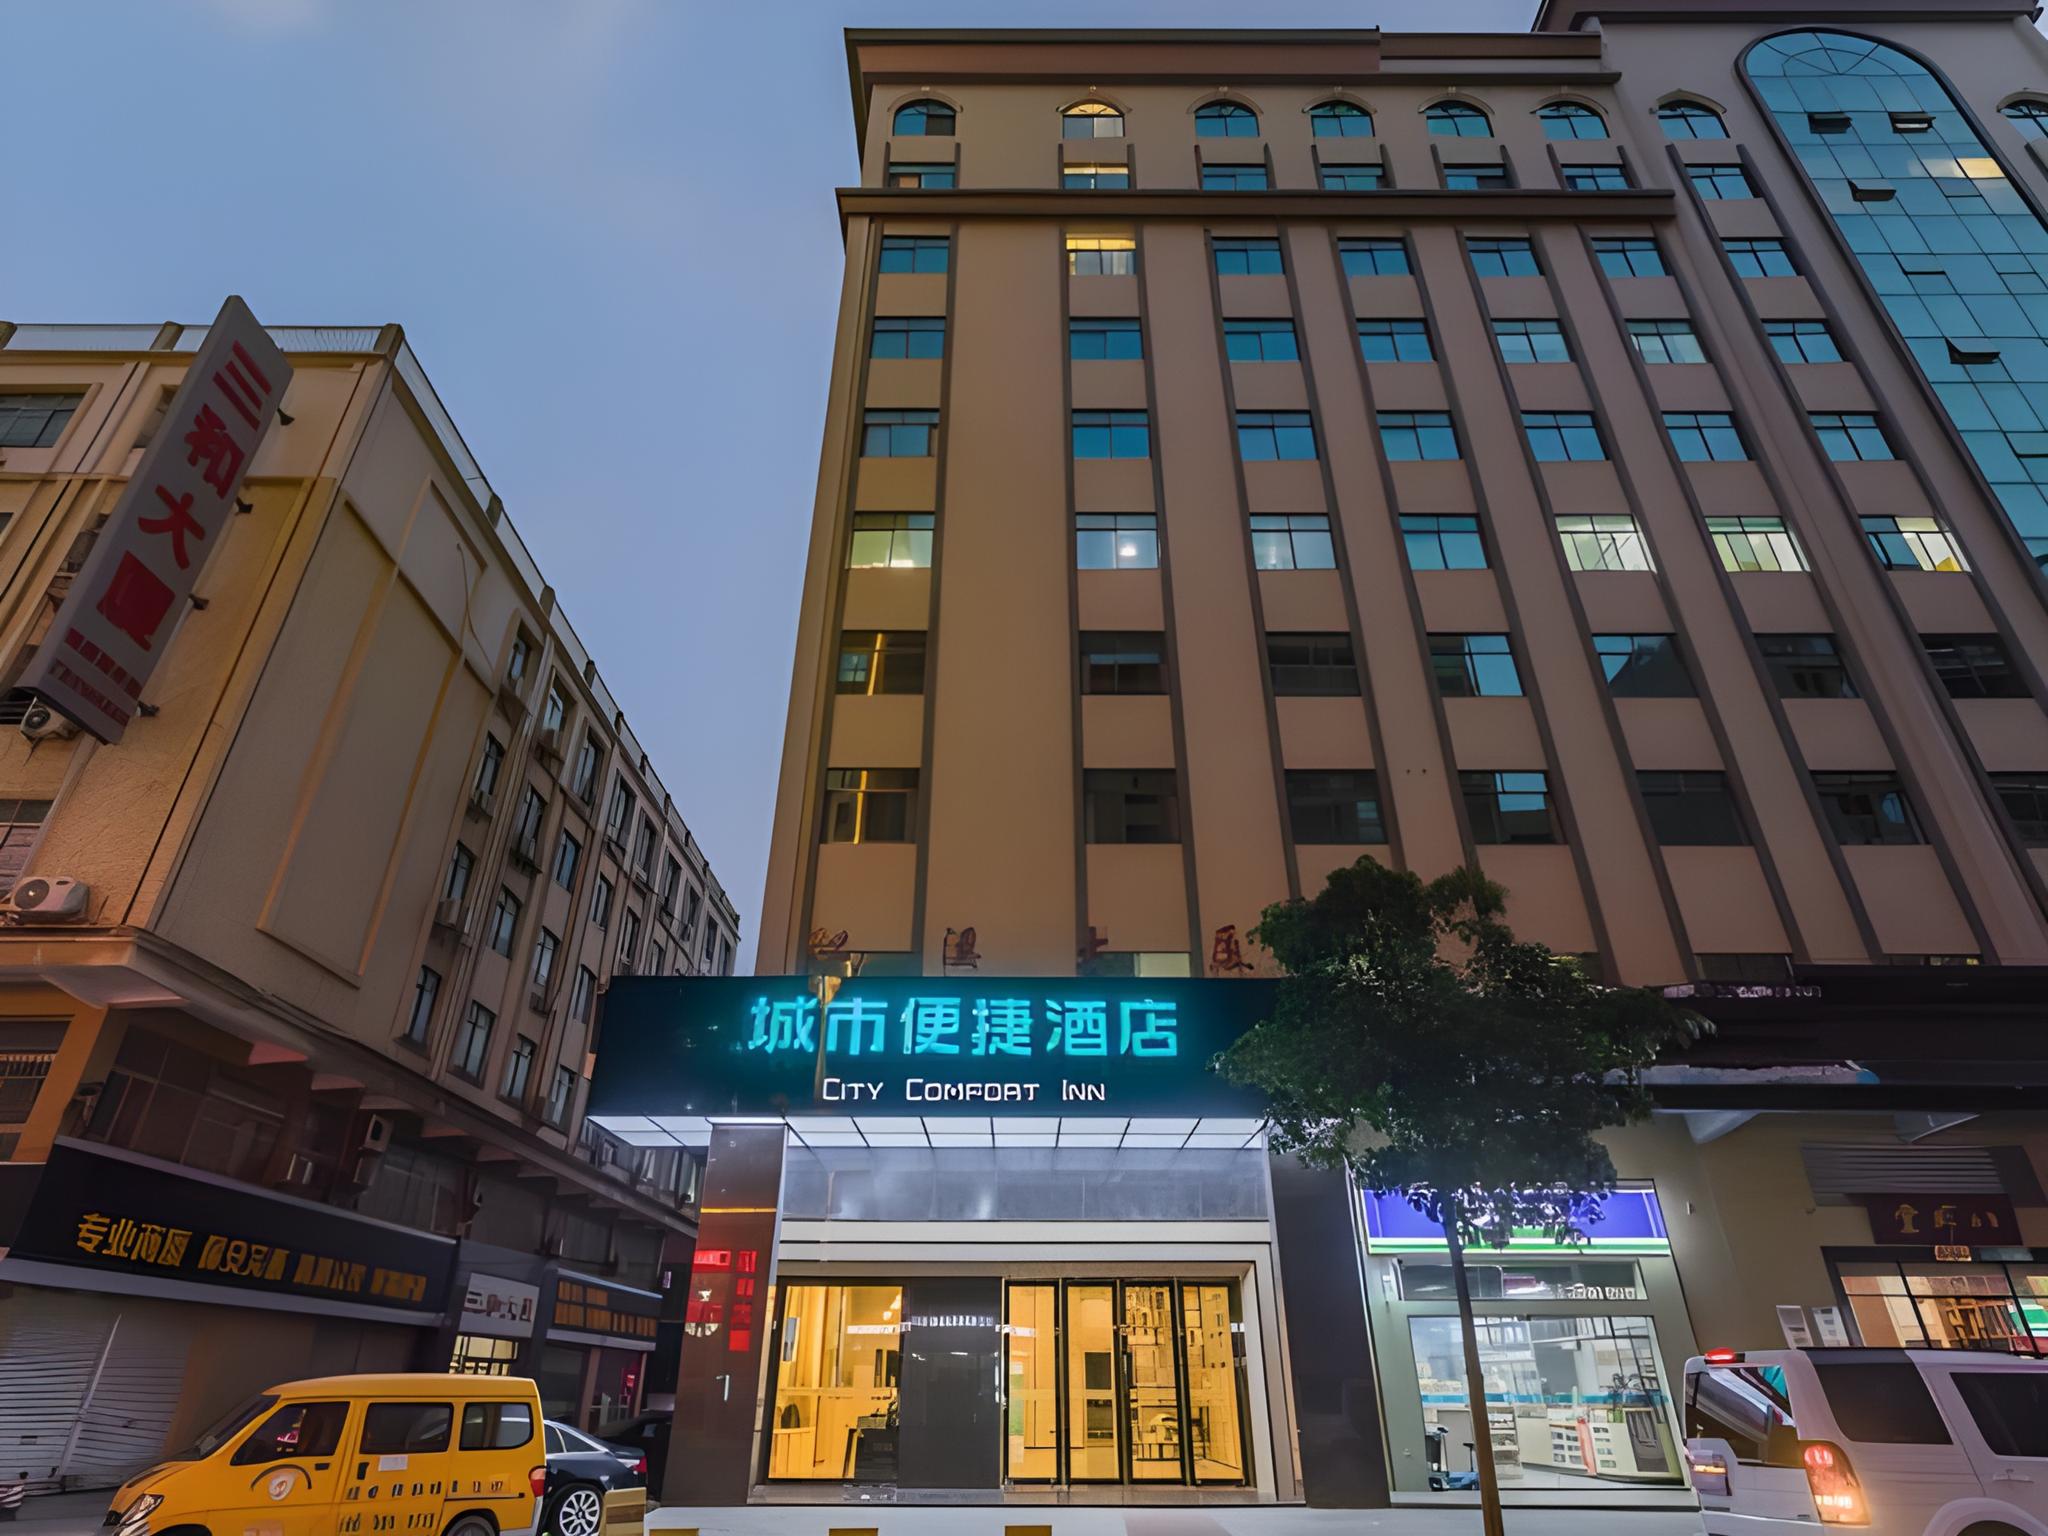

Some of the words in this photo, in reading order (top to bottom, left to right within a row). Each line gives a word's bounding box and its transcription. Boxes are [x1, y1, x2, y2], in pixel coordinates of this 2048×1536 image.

[748, 996, 1177, 1057] 城市便捷酒店
[823, 1078, 884, 1100] CITY
[1062, 1079, 1106, 1101] INN
